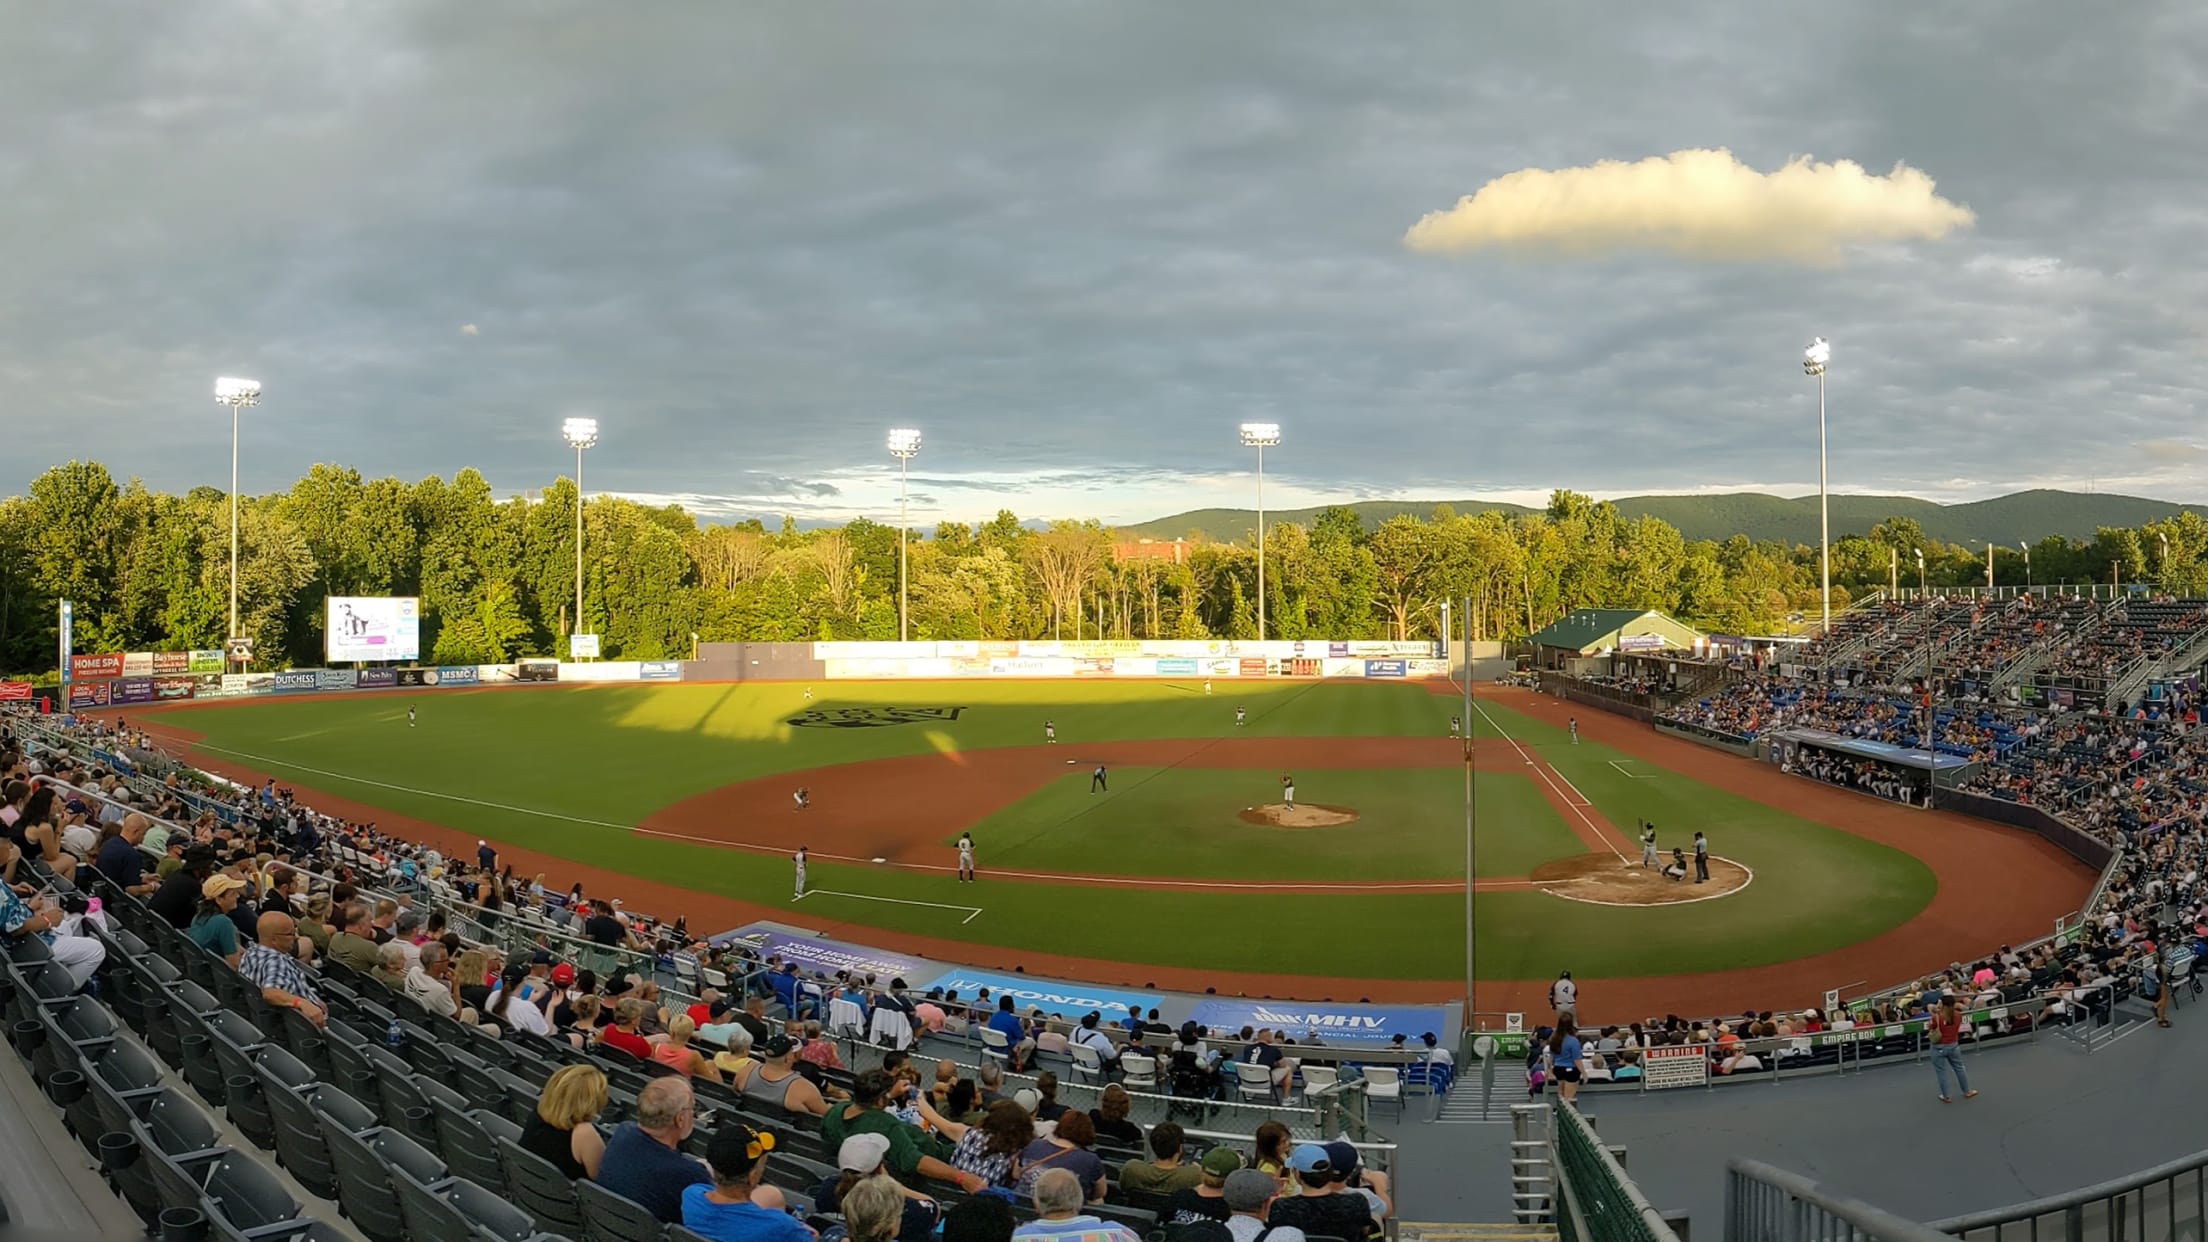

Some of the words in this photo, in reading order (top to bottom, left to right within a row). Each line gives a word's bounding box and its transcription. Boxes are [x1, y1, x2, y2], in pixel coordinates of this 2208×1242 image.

[74, 659, 101, 669] HOME
[102, 657, 120, 668] SPA
[276, 674, 315, 684] DUTCHESS
[773, 945, 811, 957] FROM
[814, 954, 858, 968] HOME
[857, 962, 906, 976] PLATE
[788, 942, 825, 954] YOUR
[824, 949, 867, 963] HOME
[868, 959, 912, 971] AWAY
[1562, 985, 1569, 994] 4
[985, 986, 1129, 1012] HONDA
[1305, 1014, 1387, 1028] MHV
[1296, 1030, 1358, 1039] FIANCIAL
[1822, 1033, 1857, 1045] EMPIRE
[1858, 1030, 1876, 1039] BOX
[1652, 1047, 1697, 1058] WARNING
